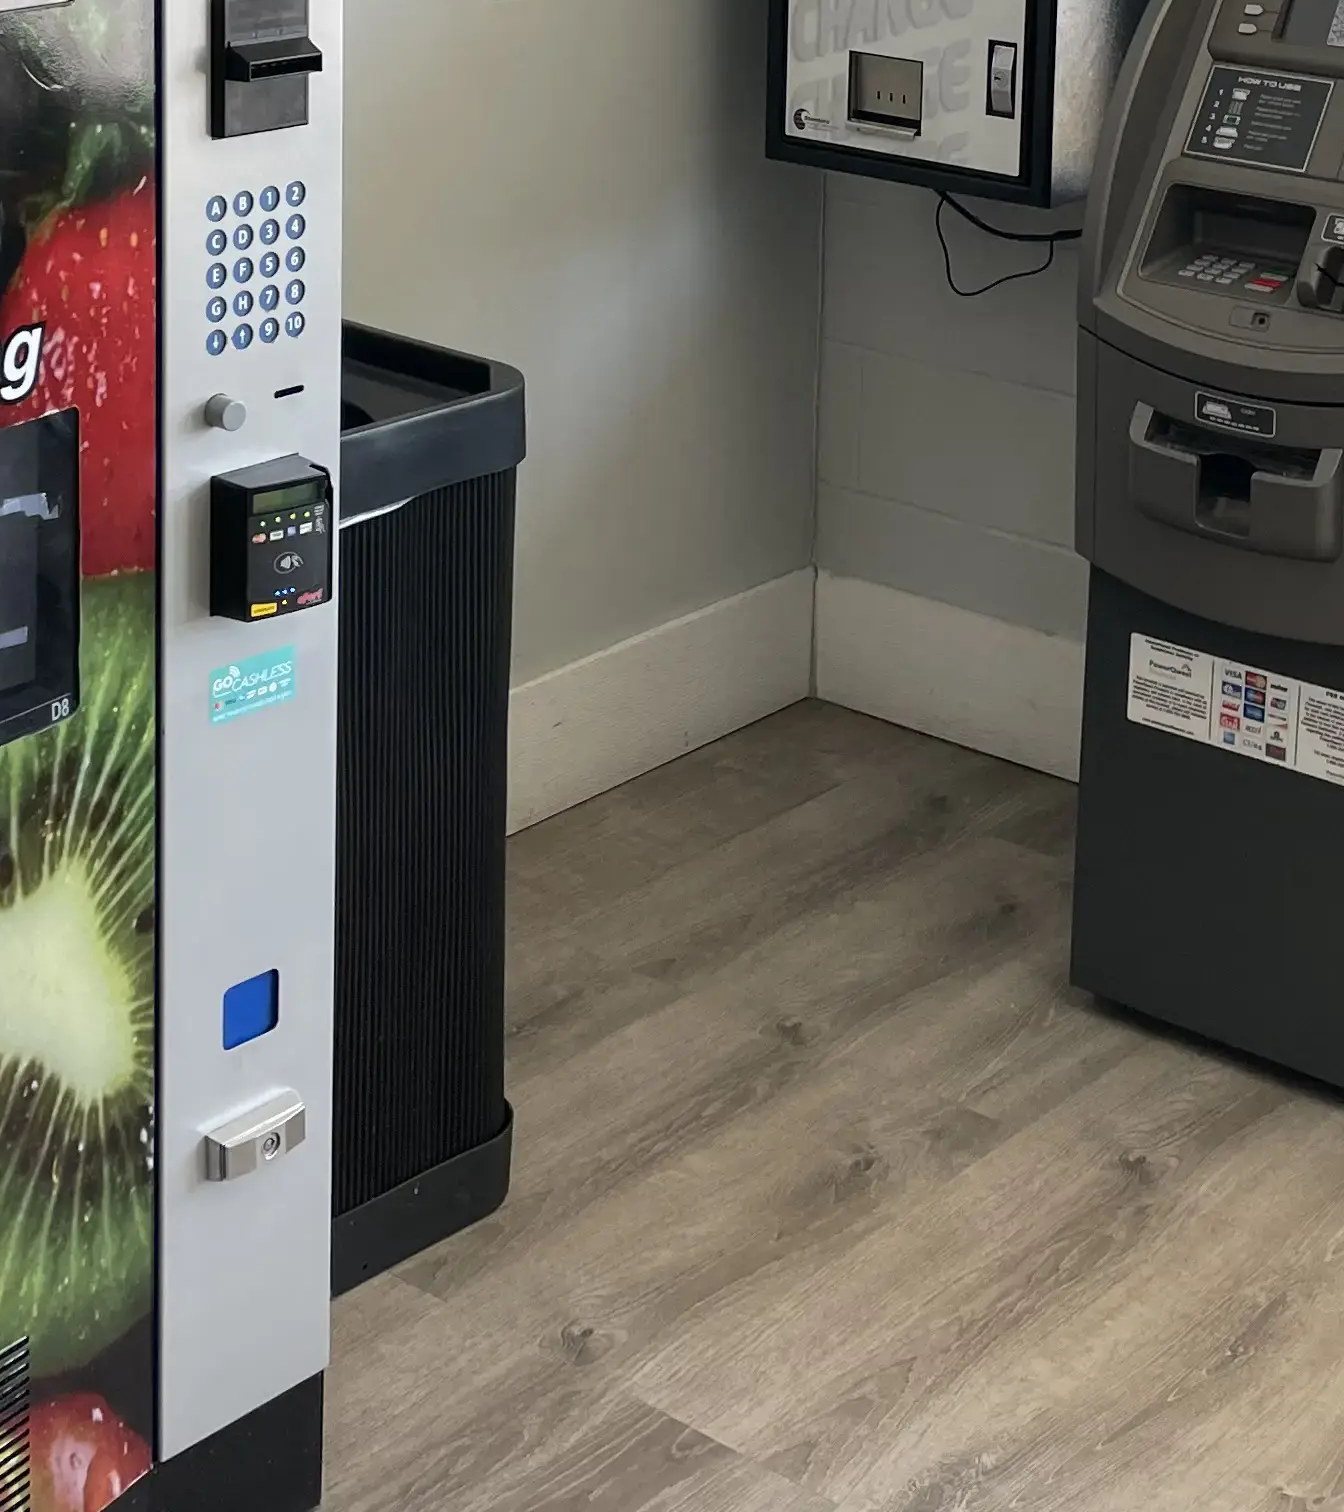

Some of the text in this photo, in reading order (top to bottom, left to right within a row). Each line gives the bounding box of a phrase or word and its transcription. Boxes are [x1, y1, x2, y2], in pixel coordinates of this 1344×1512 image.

[1238, 76, 1261, 85] HOW
[1278, 81, 1302, 91] USE
[211, 187, 299, 216] A B 1 2
[213, 219, 299, 249] C D 3 4
[213, 253, 298, 282] E F 5 6
[212, 285, 298, 316] G H 7 8
[265, 316, 302, 336] 9 10
[213, 661, 292, 691] GO CASHLESS
[1224, 669, 1242, 680] VISA
[49, 698, 67, 721] D8
